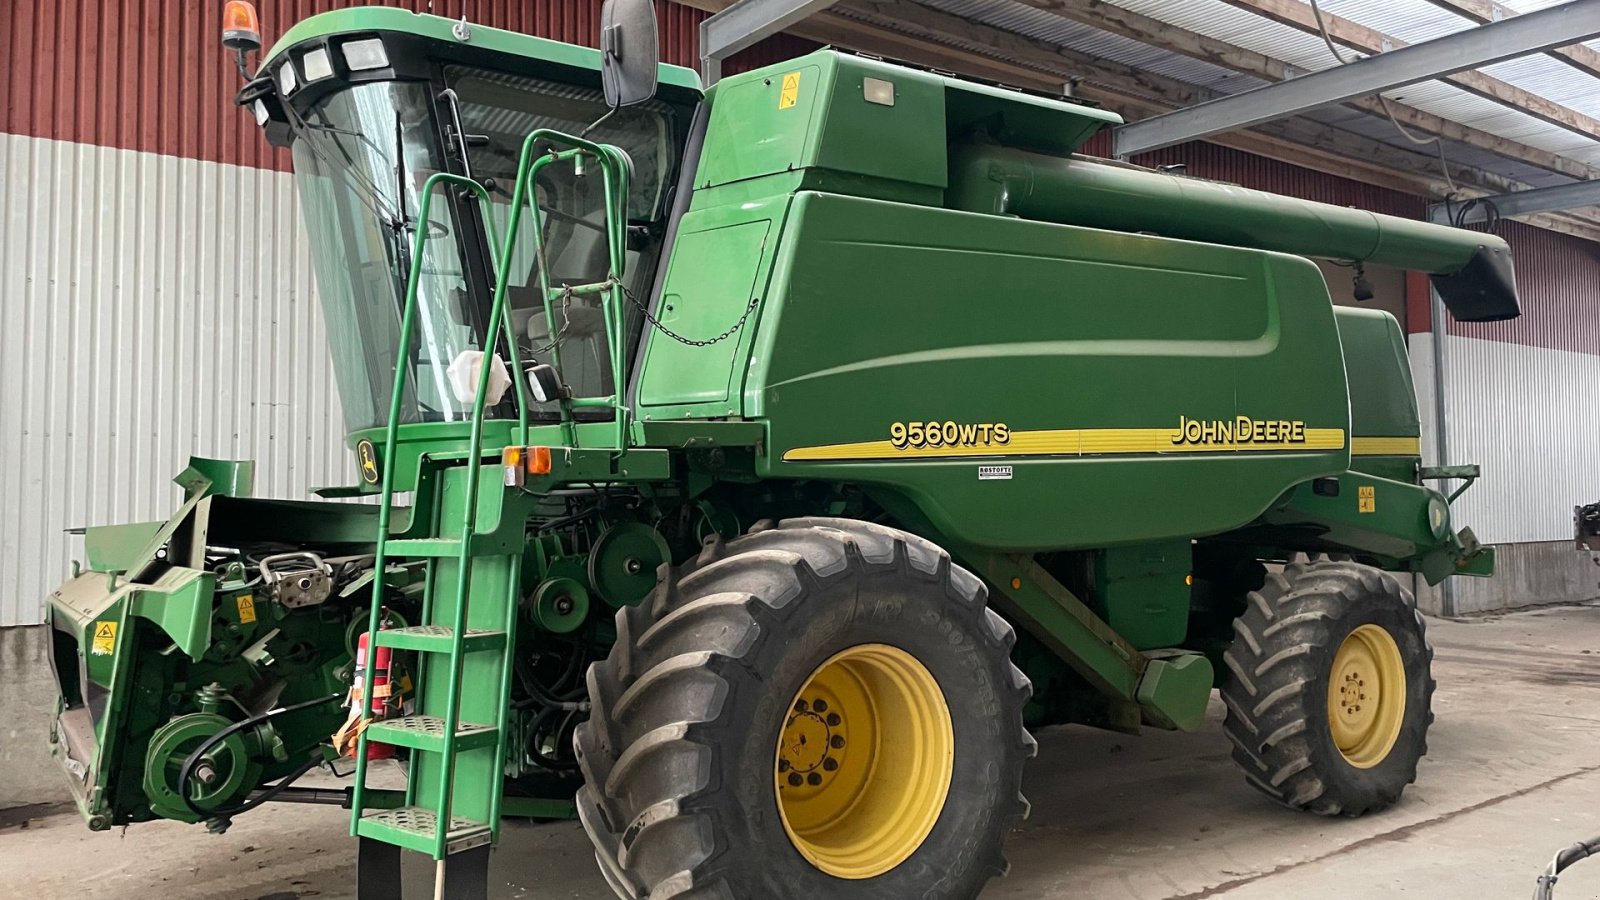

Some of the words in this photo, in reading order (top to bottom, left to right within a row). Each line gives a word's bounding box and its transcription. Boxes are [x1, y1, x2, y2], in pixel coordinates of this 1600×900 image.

[890, 420, 1010, 449] 9560WTS
[1172, 416, 1234, 444] JOHN
[1236, 415, 1305, 443] DEERE
